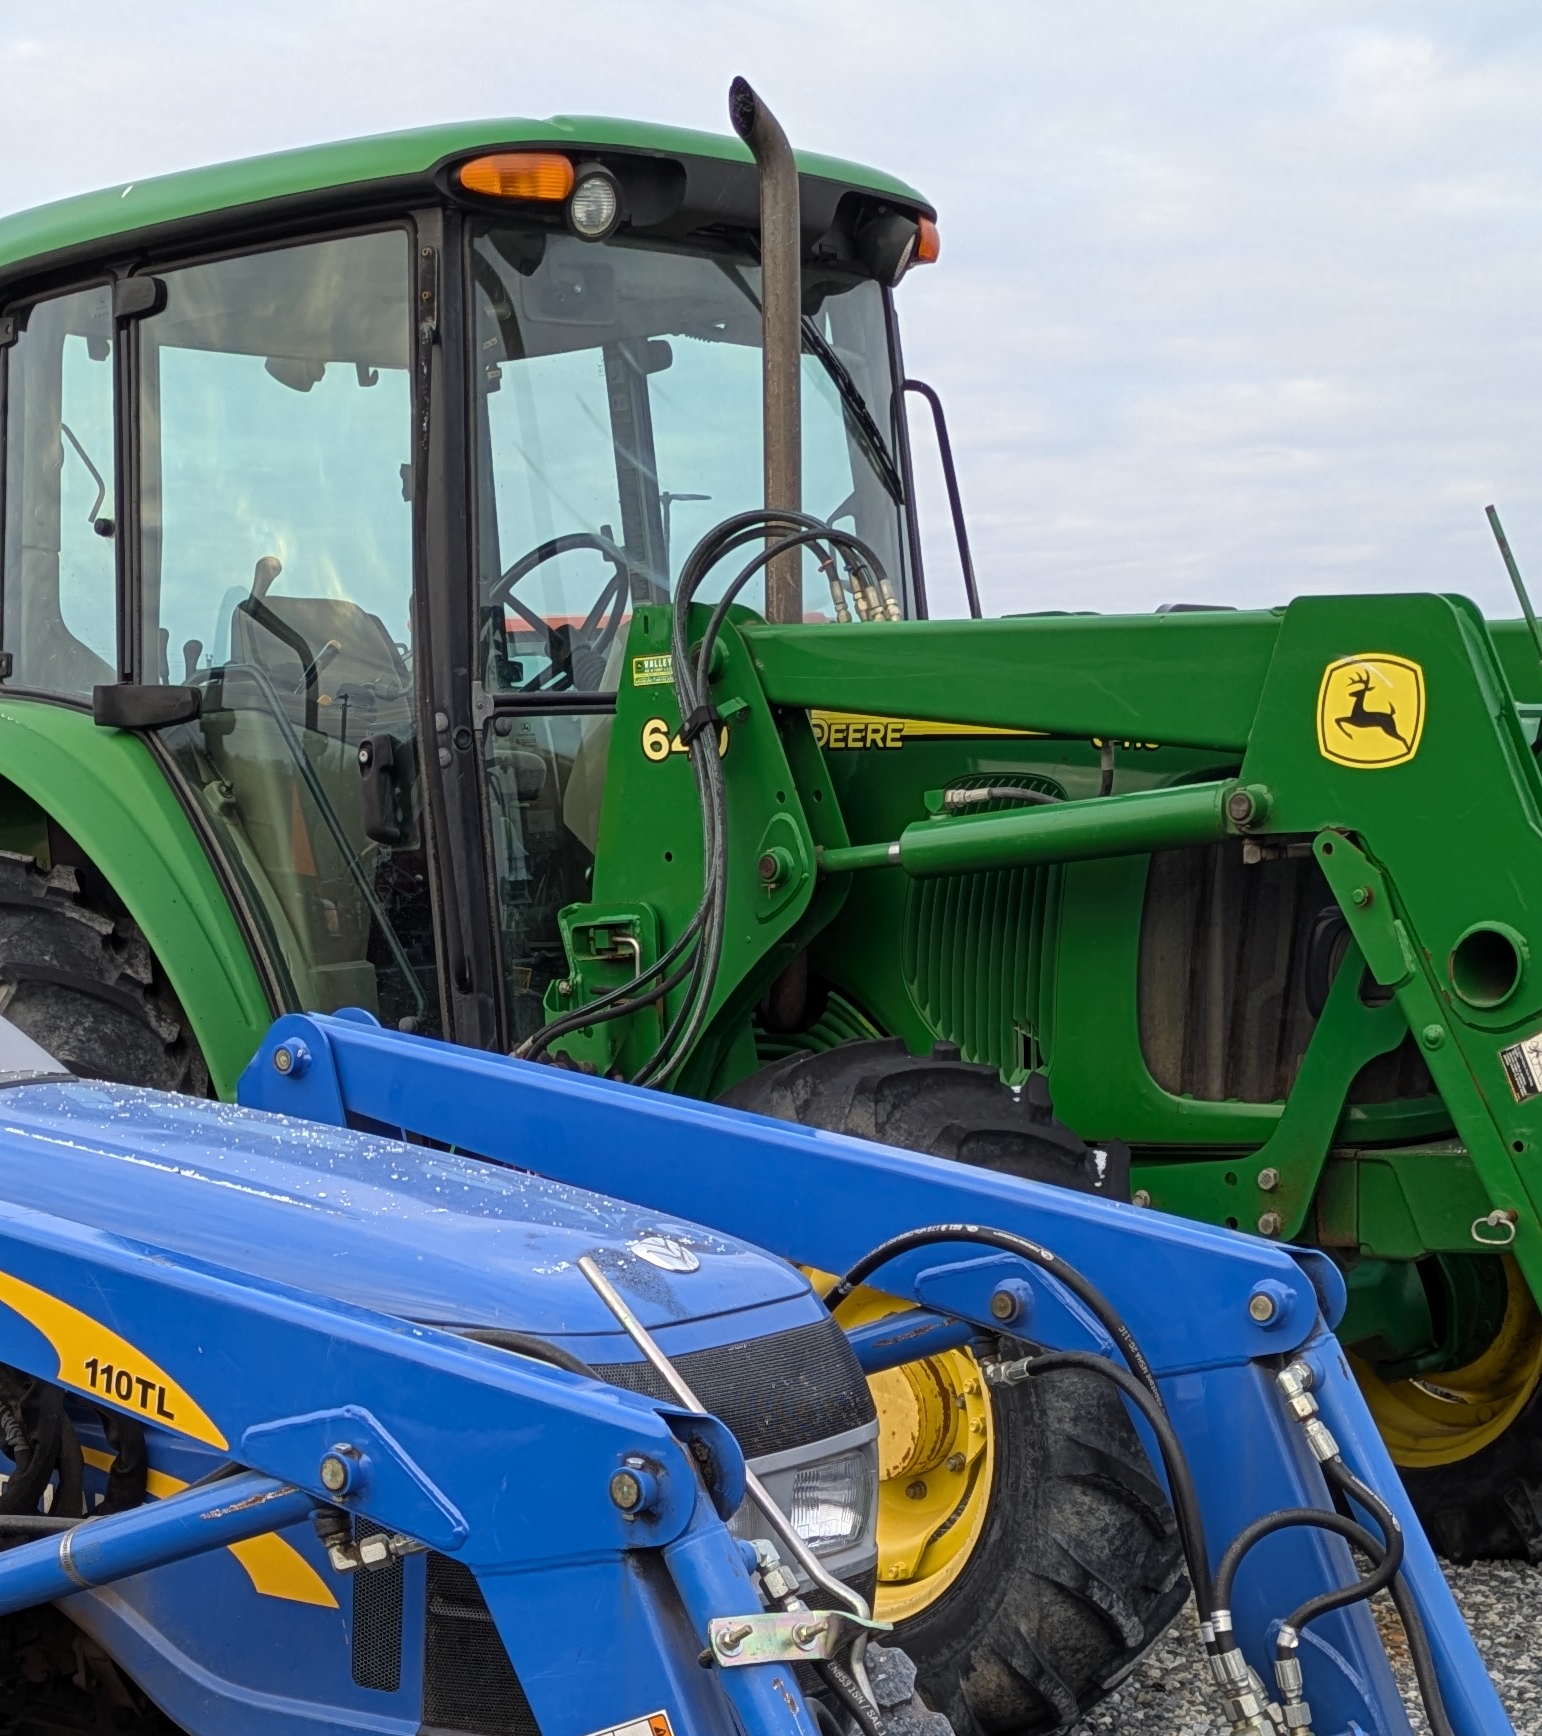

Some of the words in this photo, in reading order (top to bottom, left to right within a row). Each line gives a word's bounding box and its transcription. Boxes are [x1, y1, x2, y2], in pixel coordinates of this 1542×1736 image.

[83, 1357, 176, 1422] 110TL
[826, 1661, 851, 1688] EN853
[846, 1684, 866, 1706] 1SN
[866, 1707, 883, 1731] SAE
